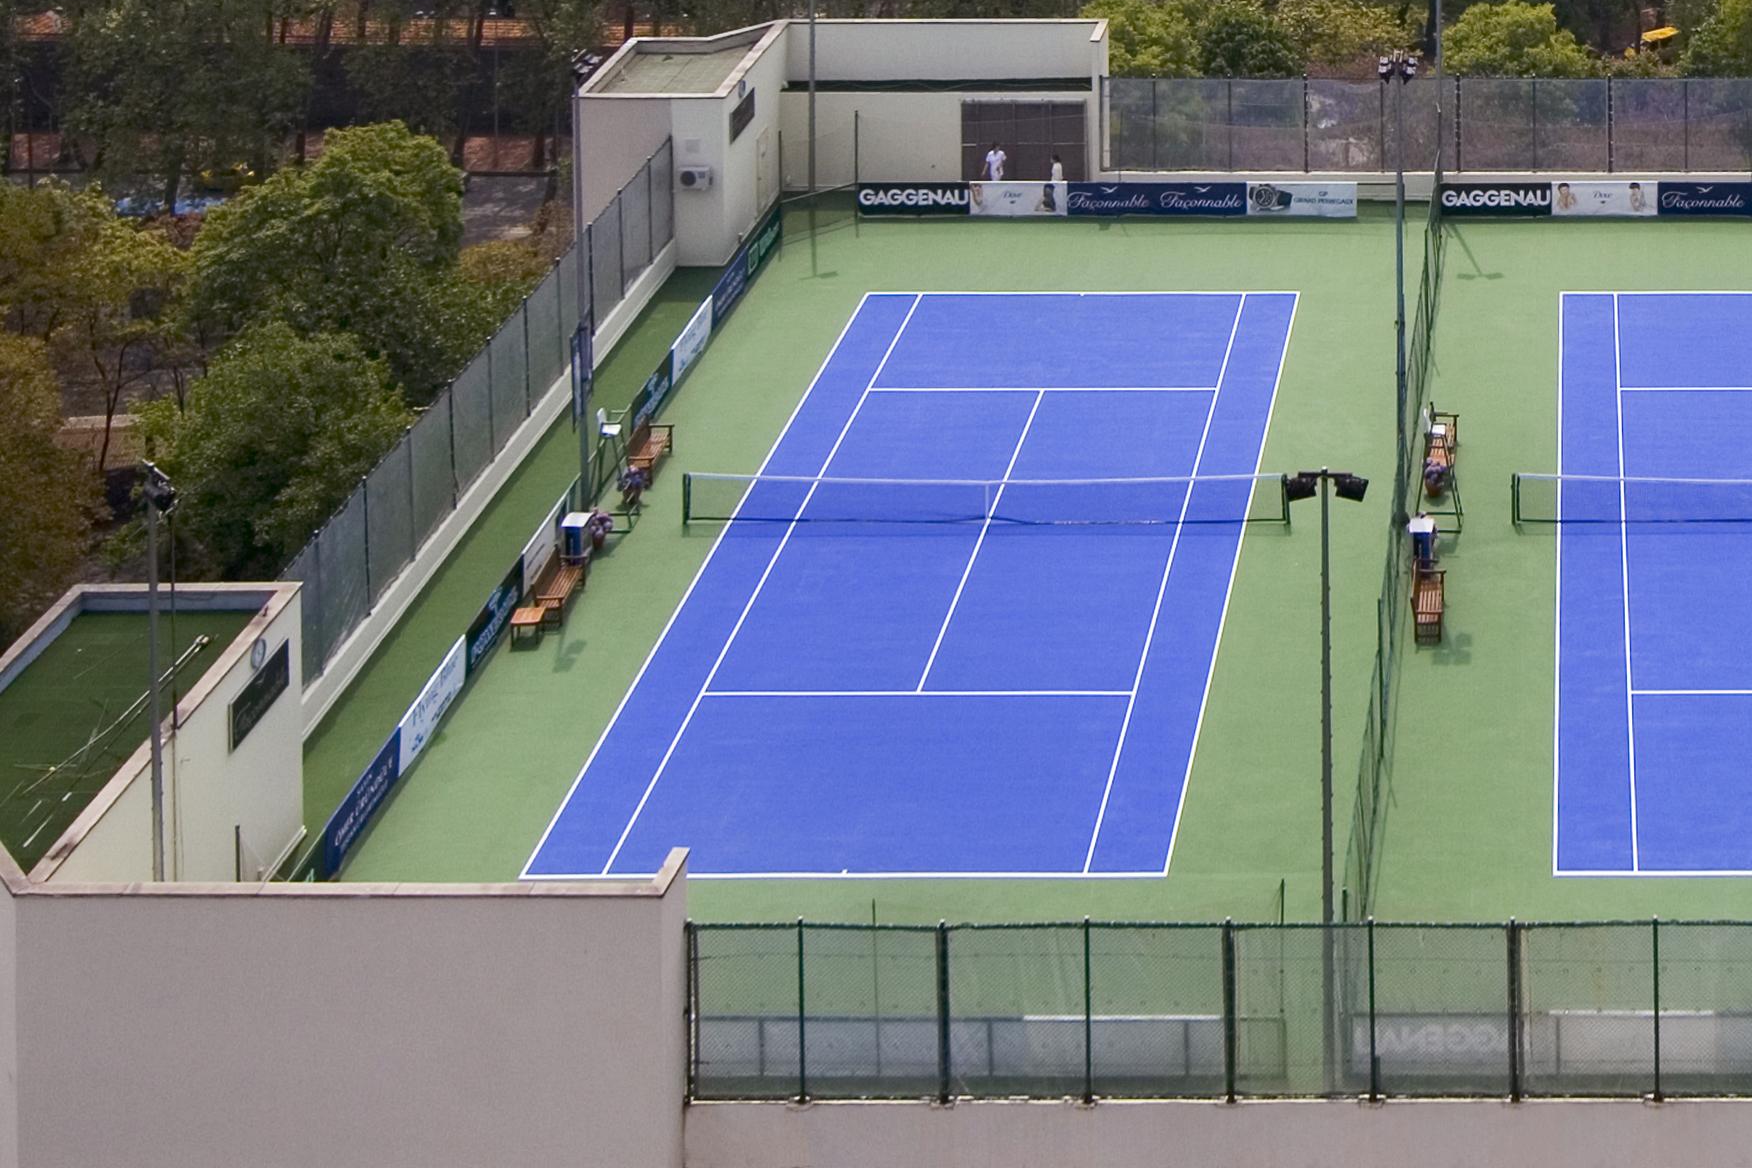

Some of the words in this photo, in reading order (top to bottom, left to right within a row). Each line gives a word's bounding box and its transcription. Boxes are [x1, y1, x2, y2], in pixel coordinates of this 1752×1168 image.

[859, 189, 969, 205] GAGGENAU
[1067, 191, 1150, 210] Façonnable
[1160, 191, 1242, 210] Façonnable
[1441, 190, 1550, 206] GAGGENAU
[1662, 191, 1744, 209] Façonnable
